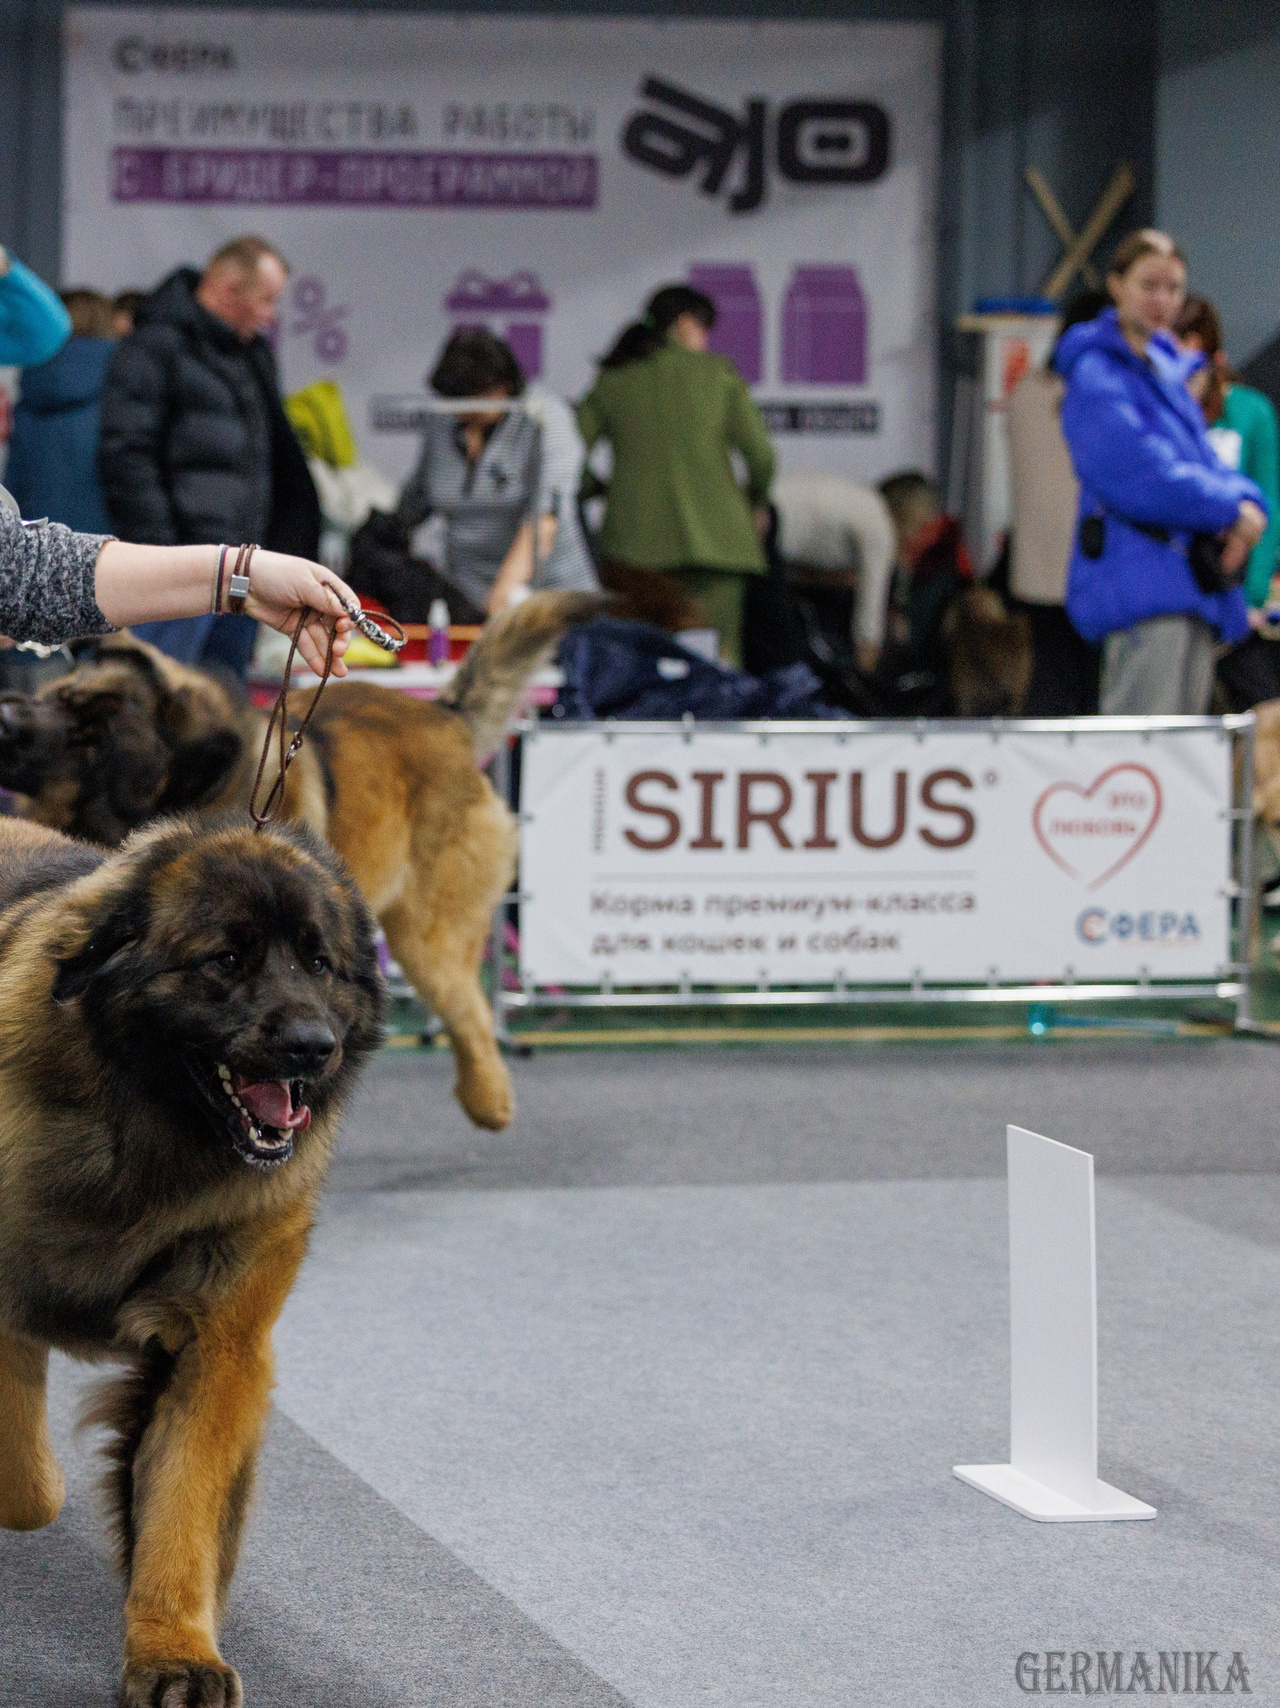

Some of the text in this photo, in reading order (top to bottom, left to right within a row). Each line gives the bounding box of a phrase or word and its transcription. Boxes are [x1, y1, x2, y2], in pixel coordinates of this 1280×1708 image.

[622, 768, 977, 851] SIRIUS
[590, 893, 695, 921] Корма
[591, 923, 900, 956] для кошек и собак
